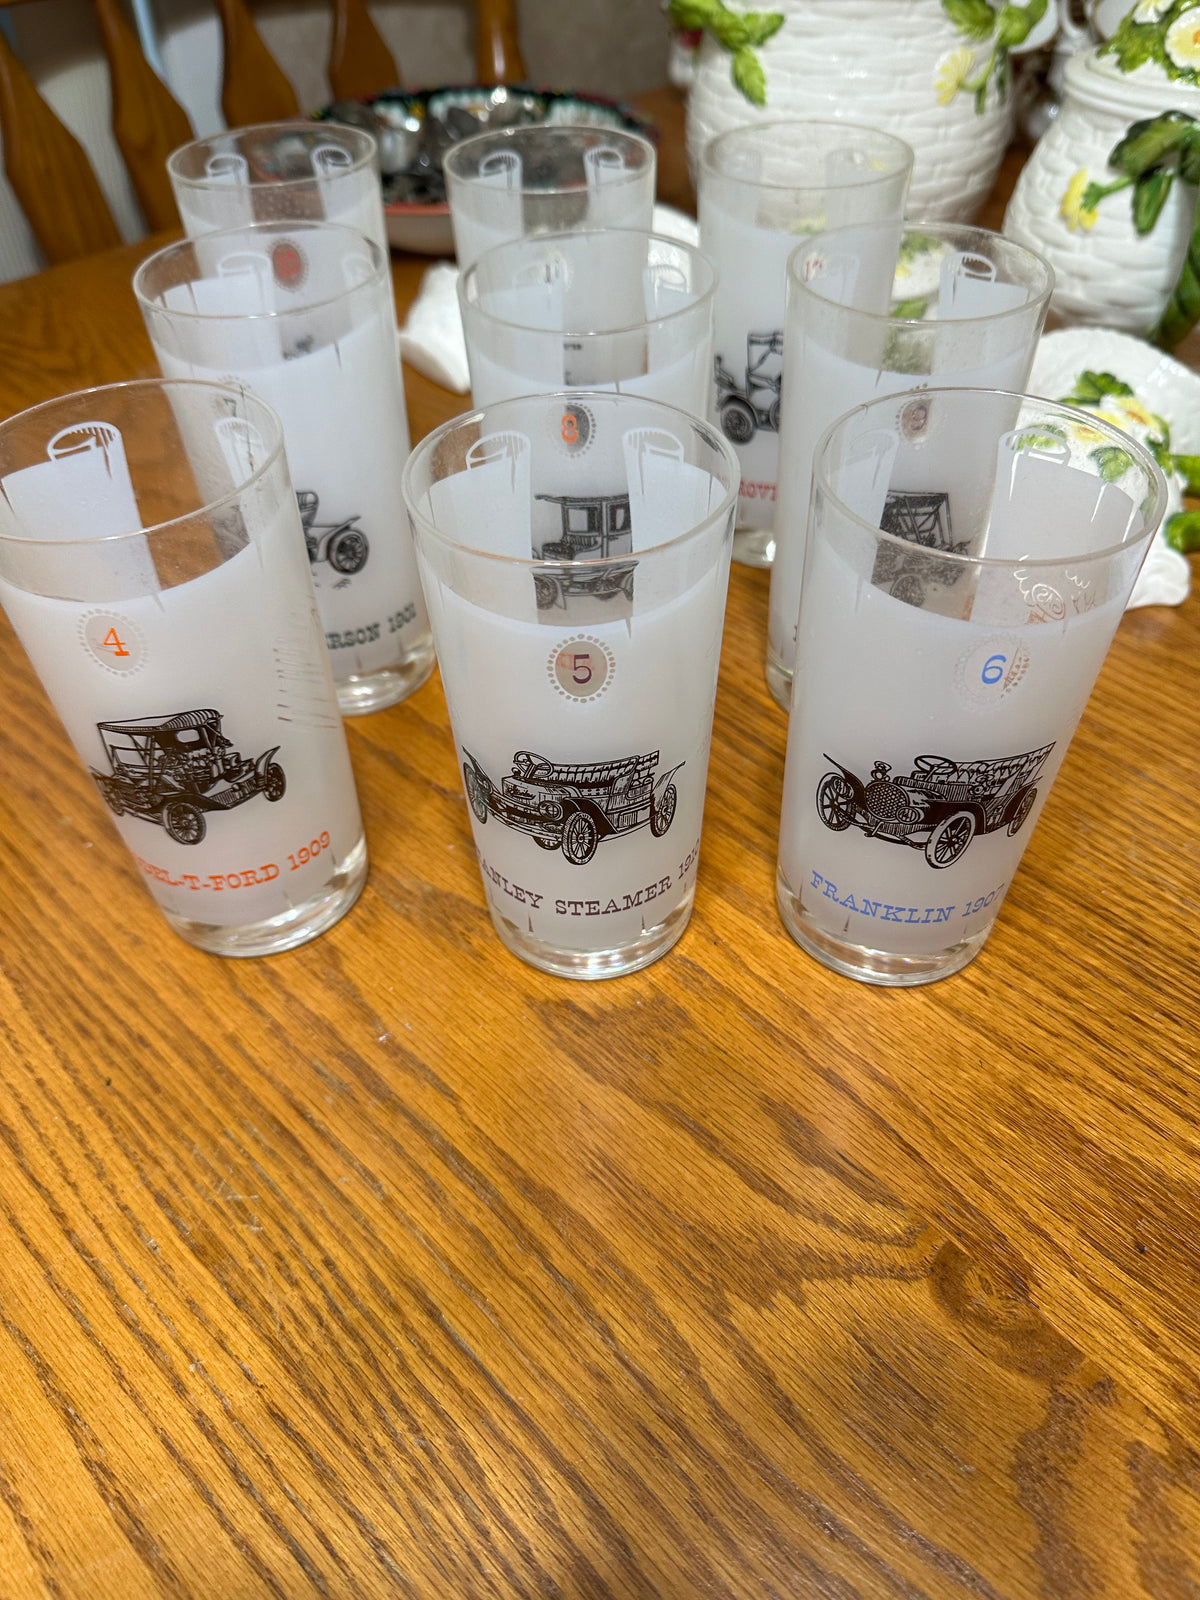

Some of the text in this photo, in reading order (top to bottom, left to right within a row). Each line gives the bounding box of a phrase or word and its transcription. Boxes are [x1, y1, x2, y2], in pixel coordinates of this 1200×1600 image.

[561, 413, 579, 444] 8
[911, 405, 928, 431] 9
[103, 627, 130, 657] 4
[572, 653, 592, 684] 5
[981, 654, 1007, 685] 6
[287, 831, 330, 871] 1909
[555, 875, 672, 916] STEAMER
[810, 870, 956, 924] FRANKLIN
